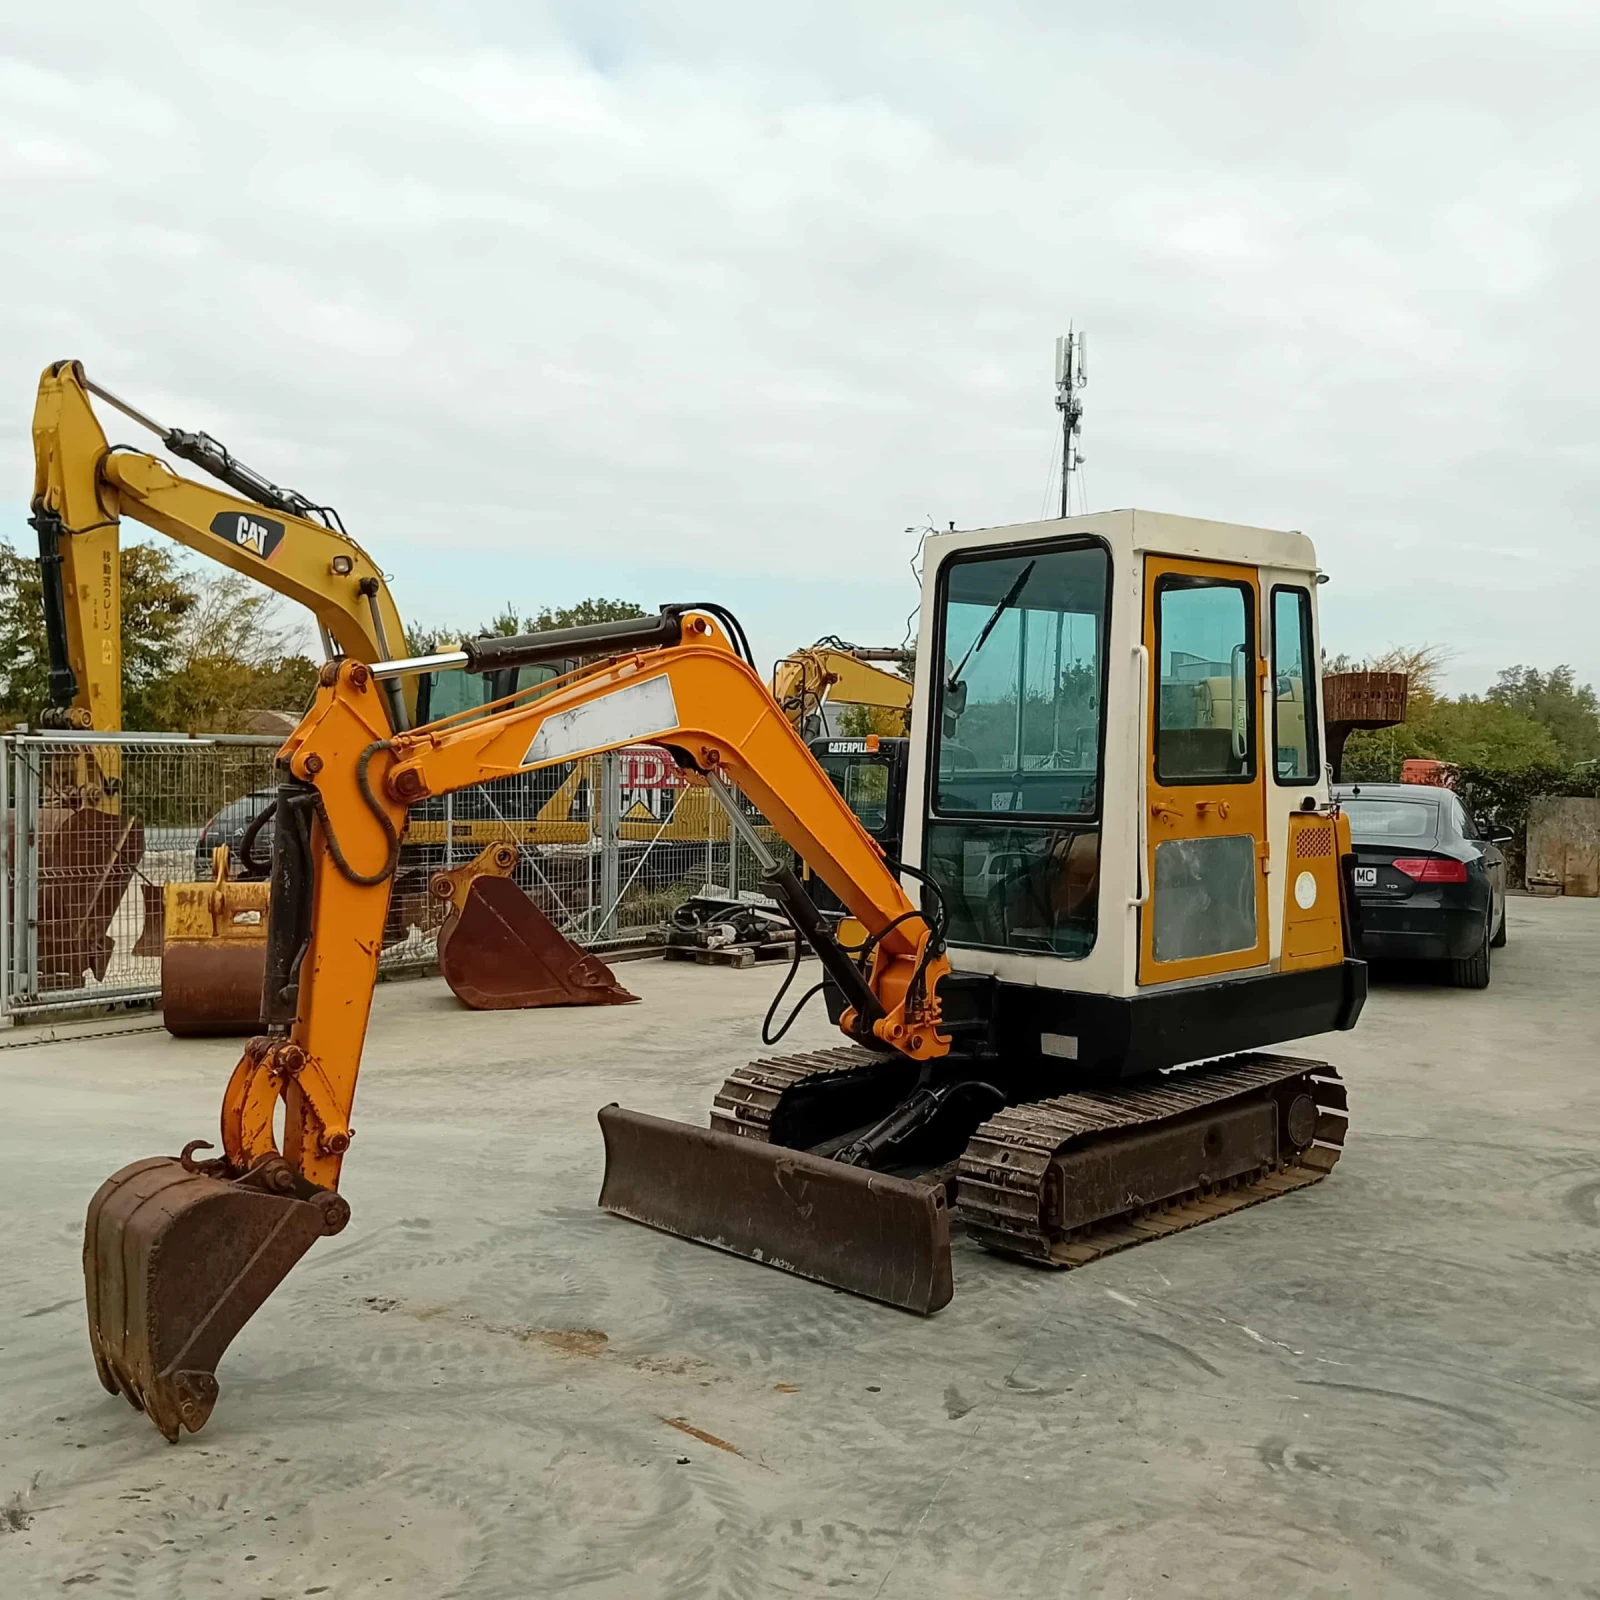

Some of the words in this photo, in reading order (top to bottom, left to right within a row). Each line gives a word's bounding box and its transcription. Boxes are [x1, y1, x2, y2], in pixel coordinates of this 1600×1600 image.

[236, 515, 268, 556] CAT
[828, 742, 879, 753] CATERPILL
[1356, 869, 1374, 882] MC
